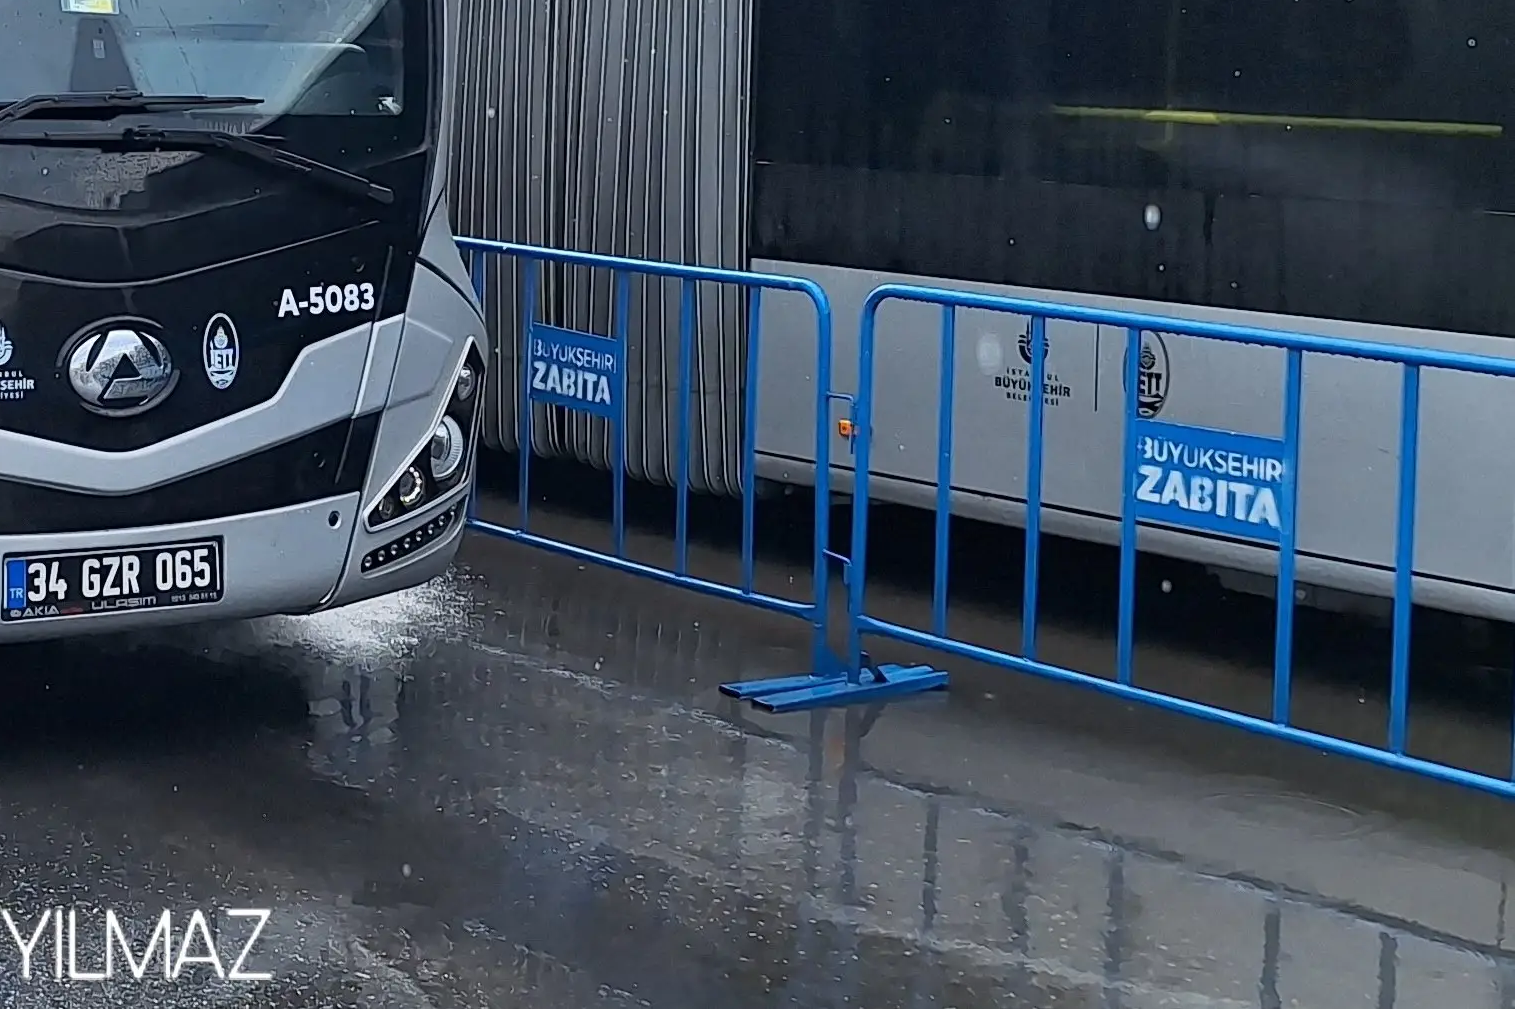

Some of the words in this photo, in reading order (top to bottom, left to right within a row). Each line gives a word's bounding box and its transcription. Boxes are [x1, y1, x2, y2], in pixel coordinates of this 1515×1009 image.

[277, 282, 375, 318] A-5083
[532, 360, 611, 406] ZABITA
[1006, 366, 1059, 382] İSTAUL
[1136, 464, 1282, 530] ZABITA
[9, 587, 24, 600] TR
[27, 561, 68, 603] 34
[82, 554, 140, 598] GZR
[155, 548, 211, 591] 065
